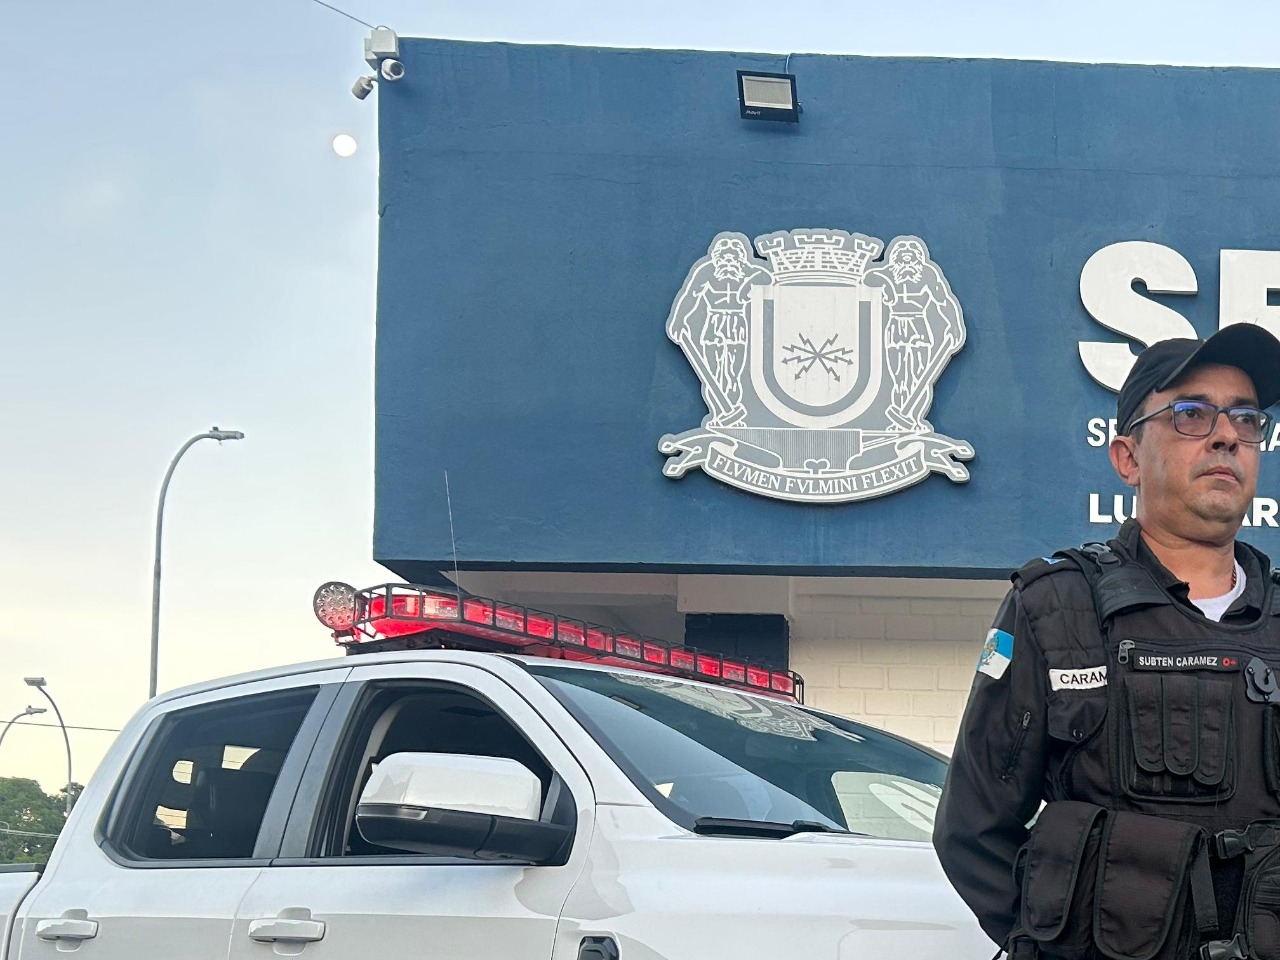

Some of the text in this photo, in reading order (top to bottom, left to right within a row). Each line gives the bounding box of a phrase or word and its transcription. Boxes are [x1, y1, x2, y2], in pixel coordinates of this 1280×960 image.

[713, 456, 919, 495] FLVMEN FVLMINI FLEXIT
[1089, 492, 1137, 524] LU
[1139, 656, 1174, 667] SUBTEN
[1176, 656, 1218, 667] CARAMEZ
[1060, 670, 1107, 685] CARAM
